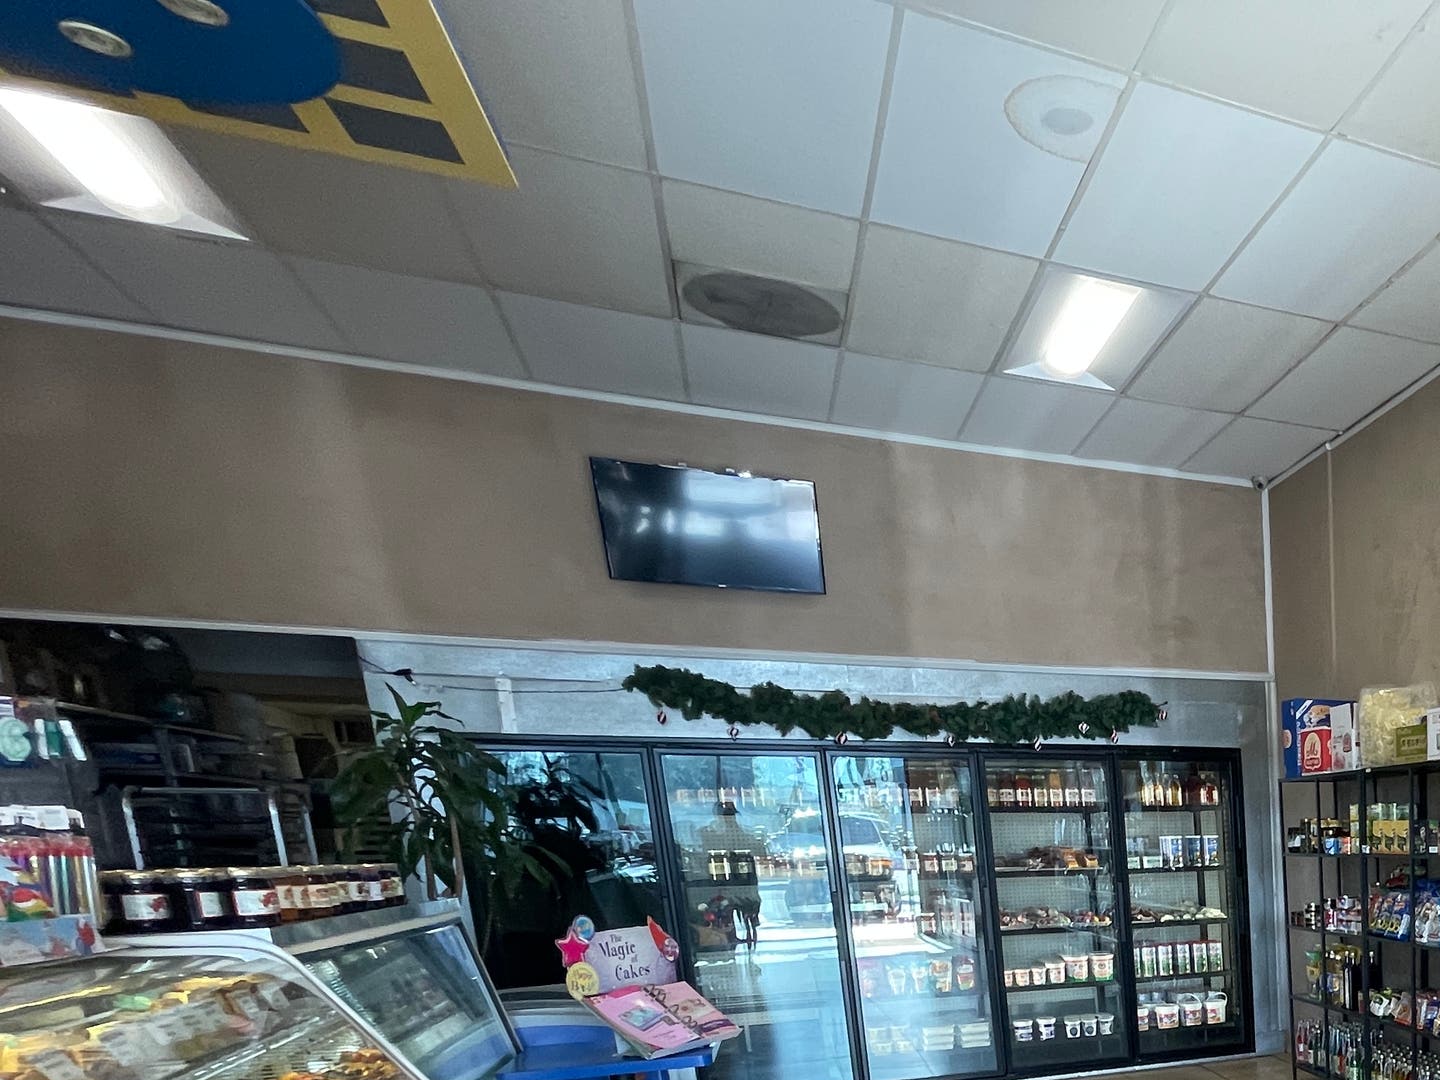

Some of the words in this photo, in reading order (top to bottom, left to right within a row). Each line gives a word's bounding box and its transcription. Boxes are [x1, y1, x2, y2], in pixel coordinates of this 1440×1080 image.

[610, 934, 622, 944] The
[598, 942, 636, 960] Magic
[615, 964, 650, 981] Cakes
